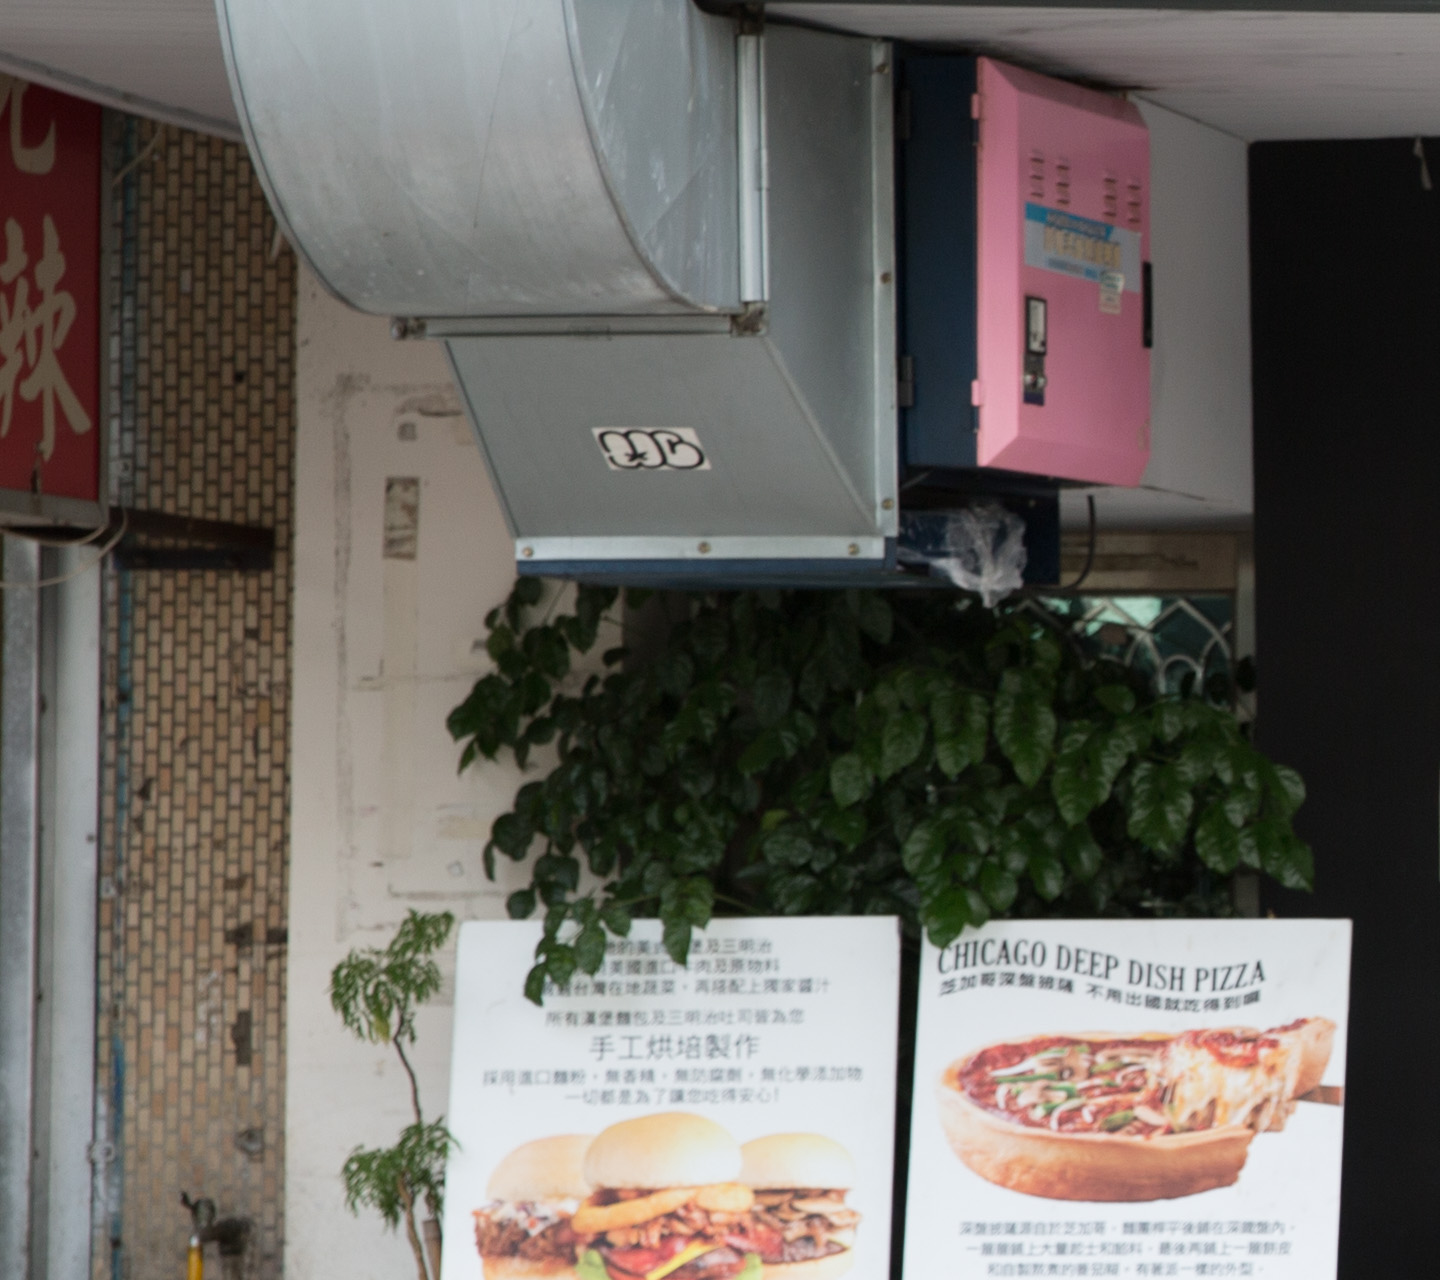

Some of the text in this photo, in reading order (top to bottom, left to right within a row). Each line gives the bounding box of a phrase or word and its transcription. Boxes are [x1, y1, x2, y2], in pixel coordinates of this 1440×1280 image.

[937, 938, 1267, 993] CHICAGO DEEP DISH PIZZA
